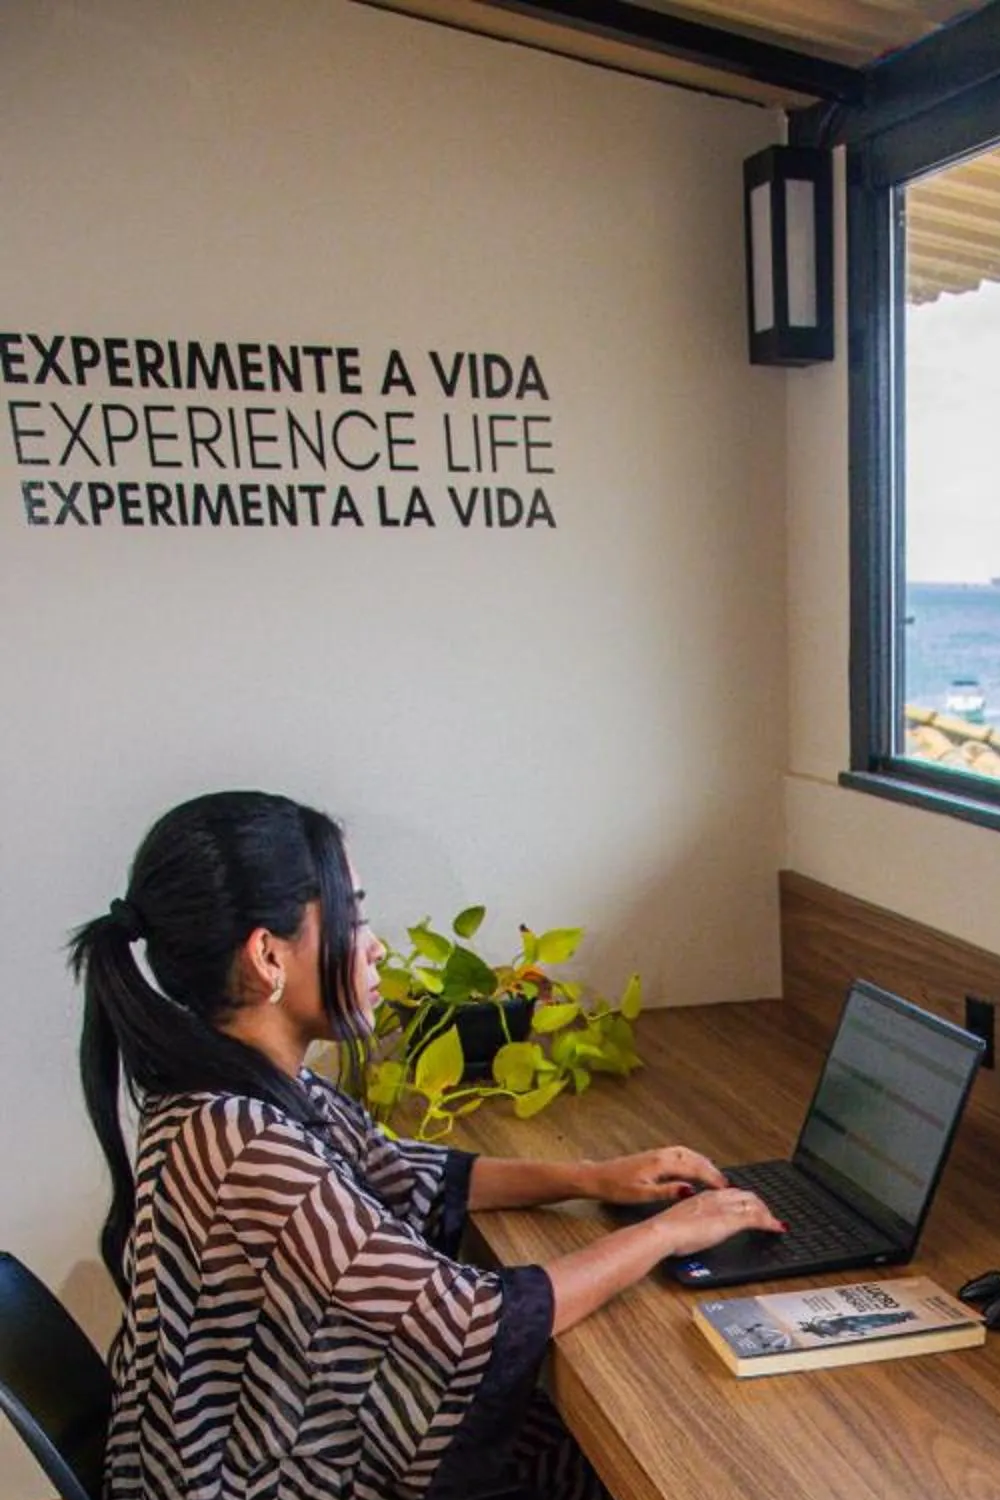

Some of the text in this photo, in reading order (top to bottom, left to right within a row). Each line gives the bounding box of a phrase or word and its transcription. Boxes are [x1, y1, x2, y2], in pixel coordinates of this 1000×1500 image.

[0, 332, 550, 401] EXPERIMENTE A VIDA
[8, 400, 556, 475] EXPERIENCE LIFE
[21, 480, 556, 528] EXPERIMENTA LA VIDA
